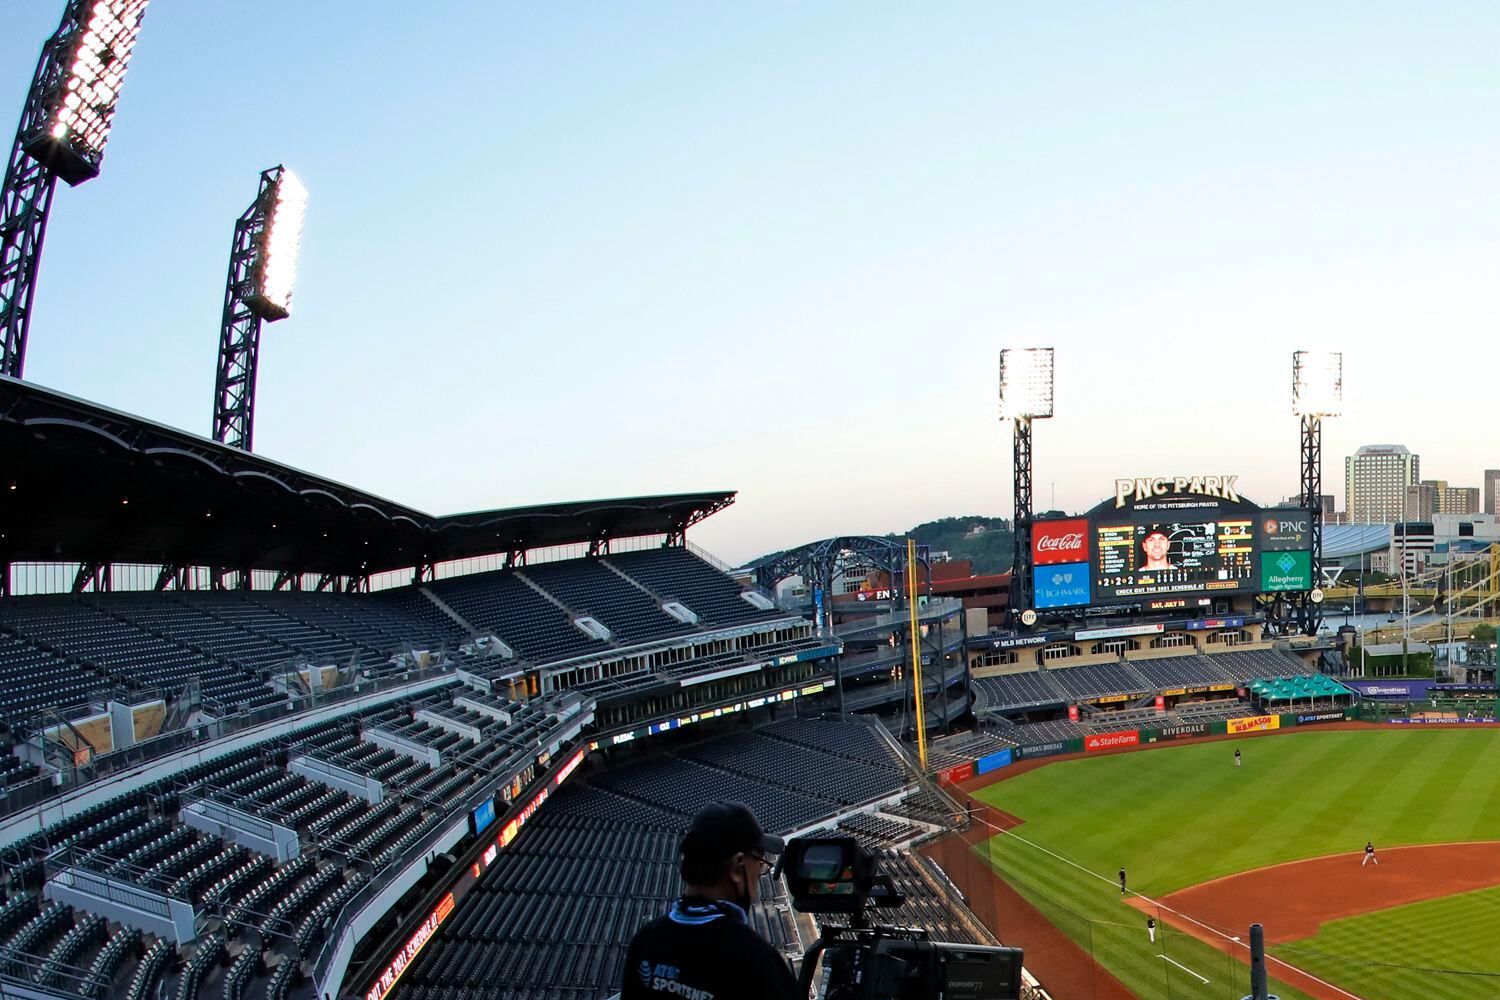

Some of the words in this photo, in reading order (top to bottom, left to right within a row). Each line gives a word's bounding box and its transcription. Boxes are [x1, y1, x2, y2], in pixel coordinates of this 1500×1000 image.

[1115, 478, 1169, 509] PNC
[1173, 475, 1240, 504] PARK
[1240, 526, 1246, 535] 2
[1280, 521, 1307, 533] PNC
[1103, 578, 1109, 587] 2
[1115, 577, 1121, 586] 2
[1128, 576, 1133, 585] 2
[1268, 575, 1303, 584] Allegheny
[1015, 637, 1046, 646] NETWORK
[1162, 724, 1205, 736] RIVENDALE
[380, 969, 395, 995] THE
[392, 950, 407, 974] 2021
[406, 918, 432, 958] SCHEDULE
